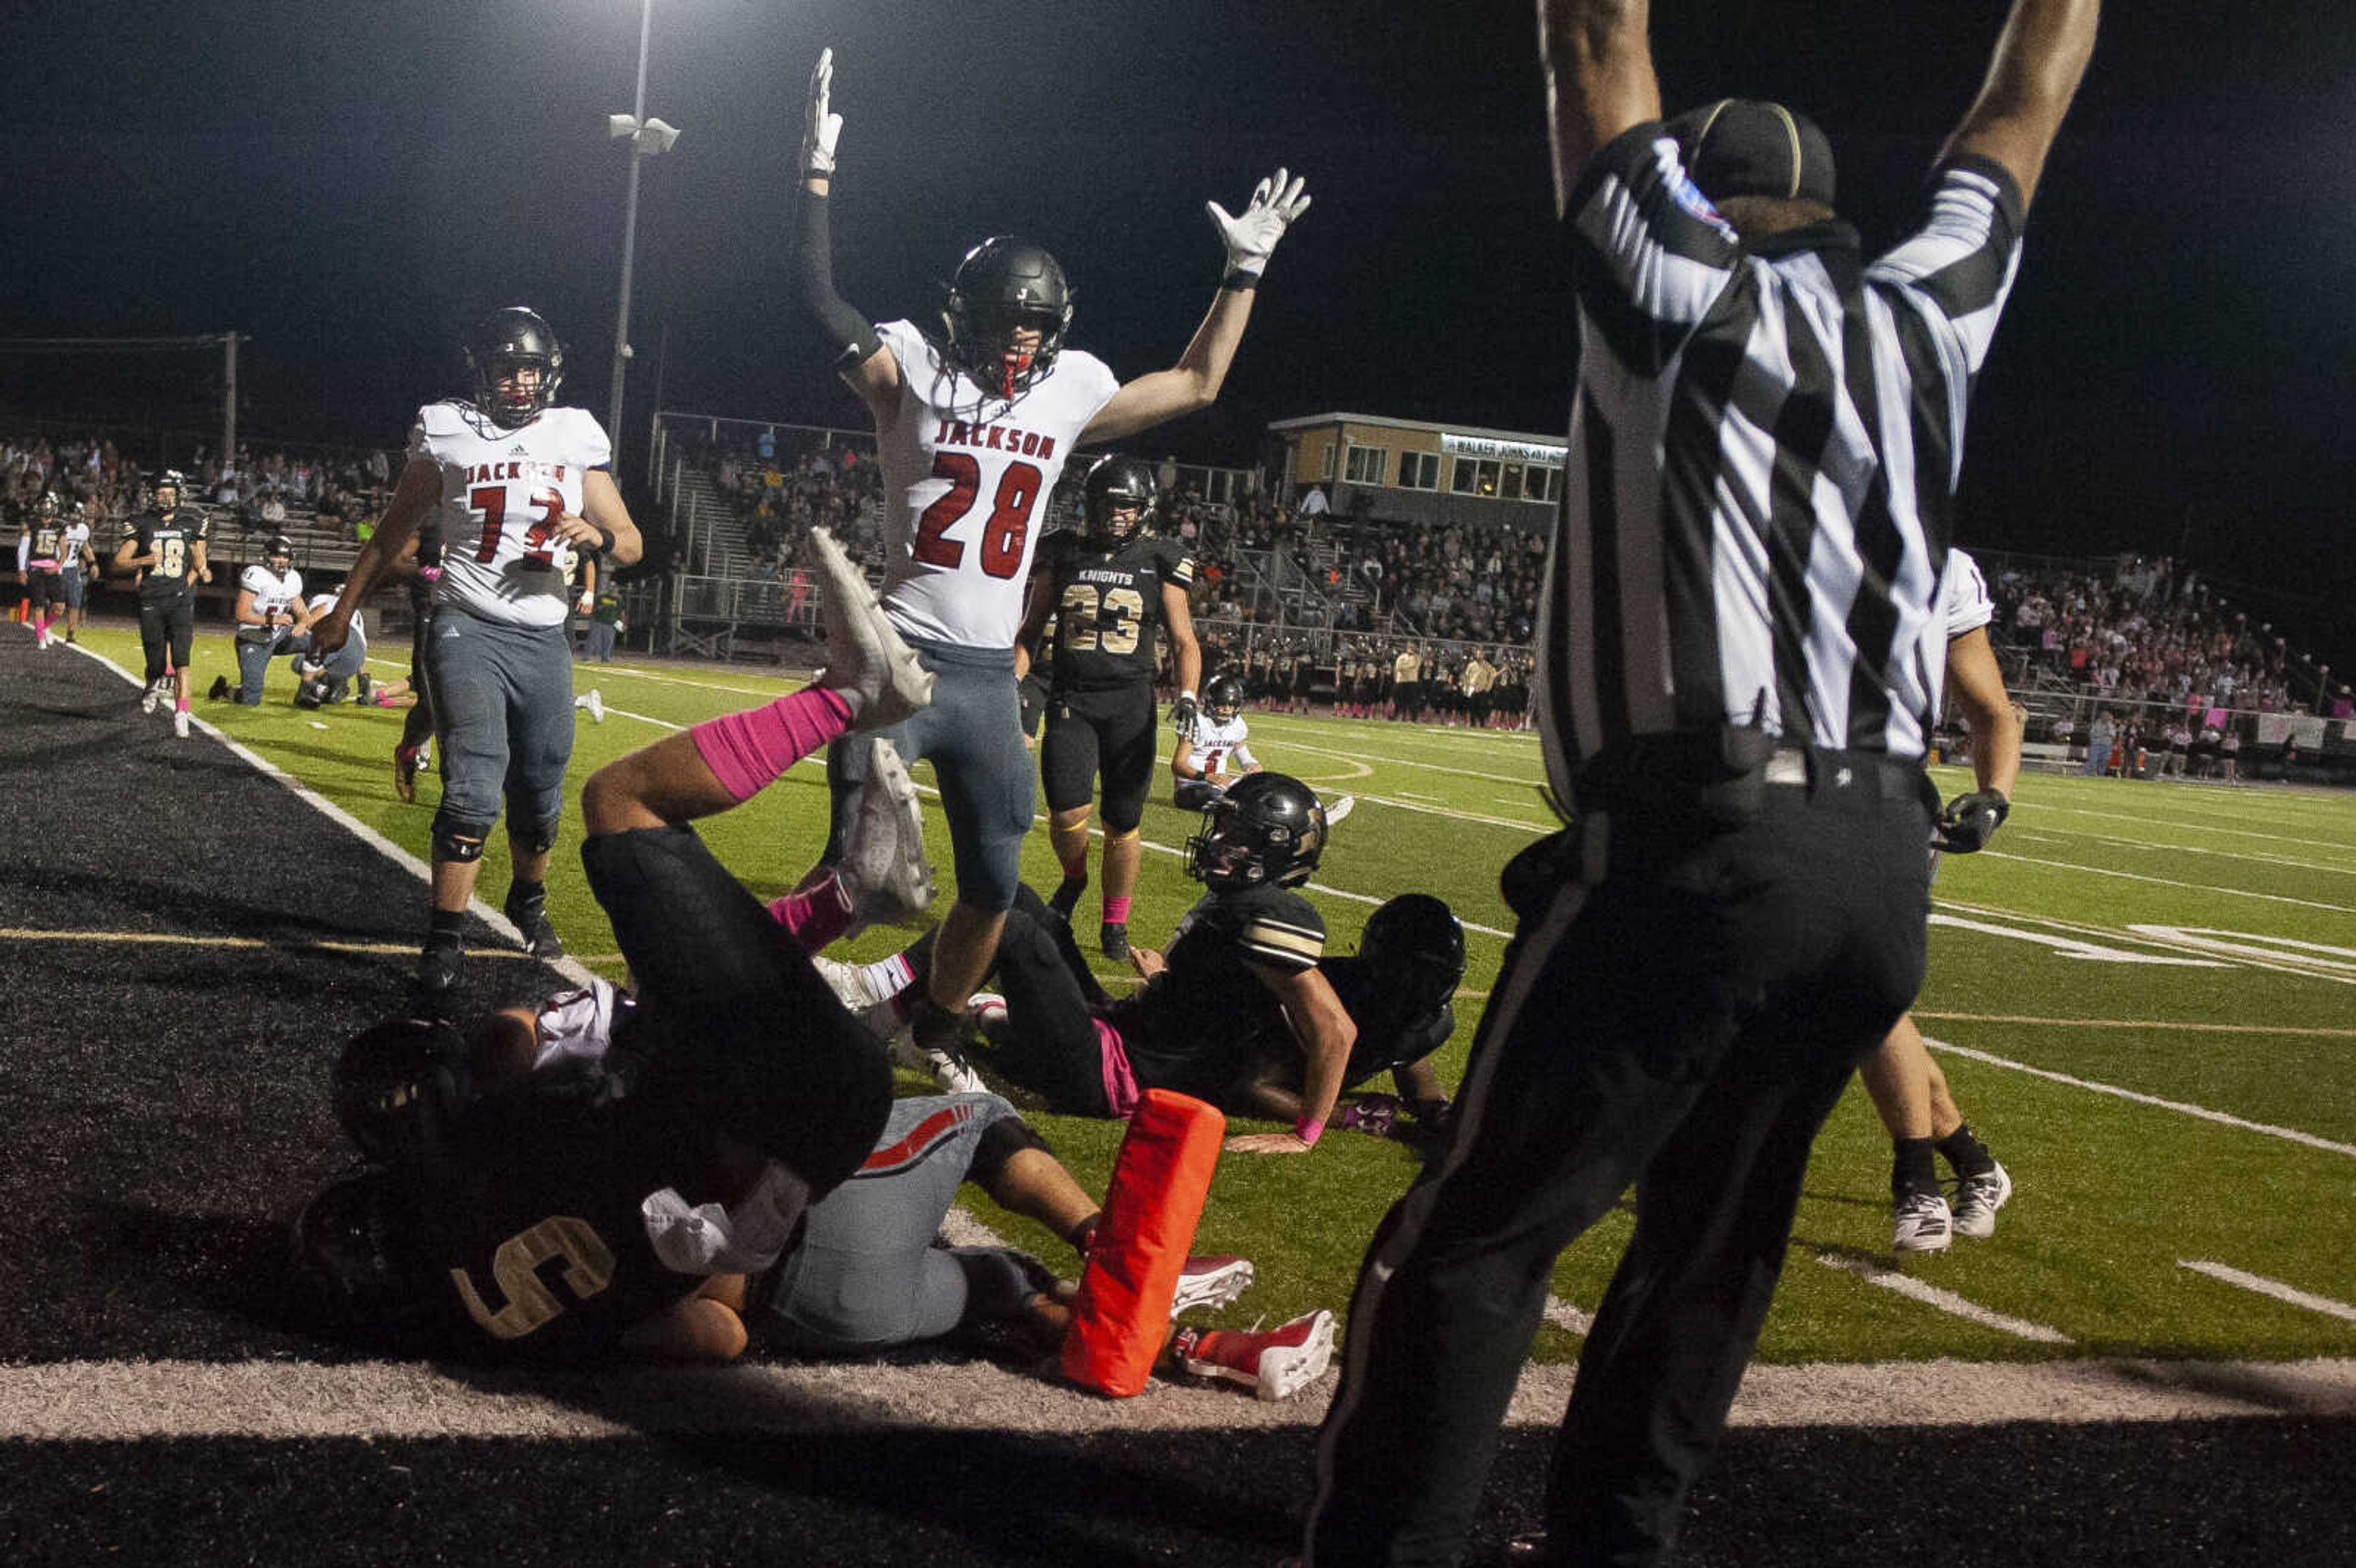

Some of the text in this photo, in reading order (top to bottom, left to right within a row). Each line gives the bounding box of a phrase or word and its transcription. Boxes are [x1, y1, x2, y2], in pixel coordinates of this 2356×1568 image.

[934, 419, 1056, 460] JACKSON
[466, 461, 566, 483] JACKN
[469, 486, 565, 572] 72
[912, 450, 1043, 580] 28
[149, 538, 185, 578] 18
[1079, 569, 1134, 585] KNIGHTS
[1061, 584, 1144, 654] 23
[448, 1214, 617, 1341] 5
